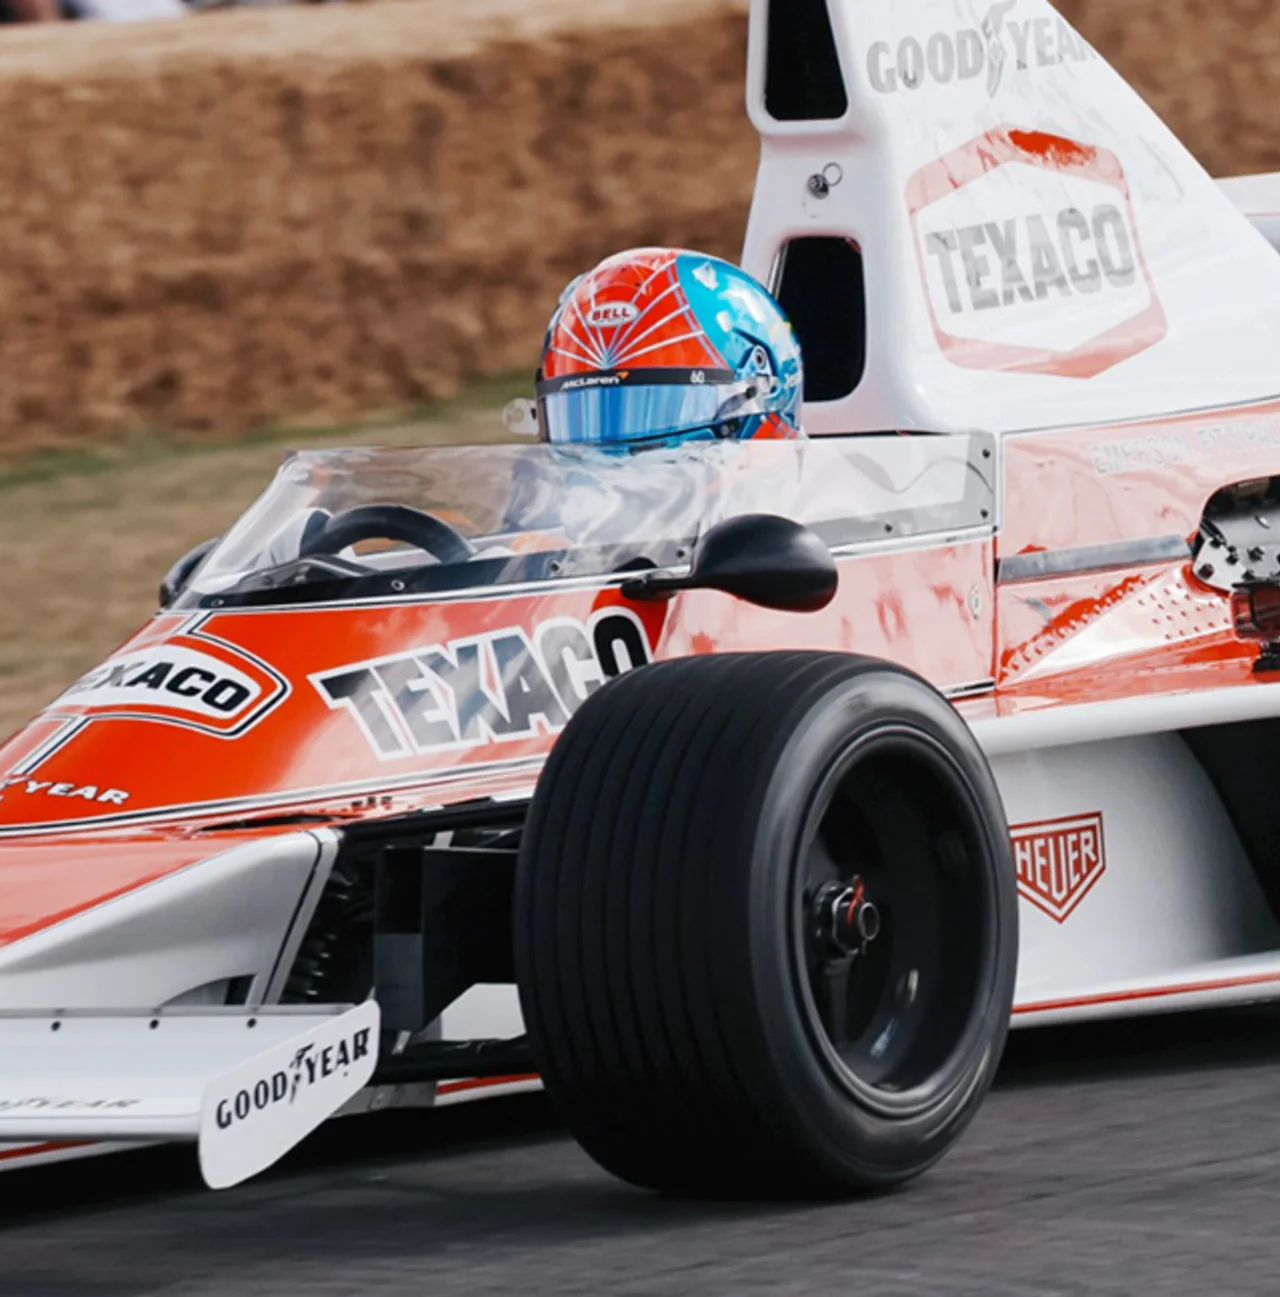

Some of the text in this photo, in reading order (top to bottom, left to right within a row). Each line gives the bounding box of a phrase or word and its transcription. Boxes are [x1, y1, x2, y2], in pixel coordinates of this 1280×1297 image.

[866, 17, 1098, 94] GOODYEA
[923, 204, 1137, 315] TEXACO
[592, 308, 630, 321] BELL
[70, 662, 251, 712] EXACO
[1014, 830, 1096, 902] HEUER
[215, 1026, 372, 1130] GOODYEAR
